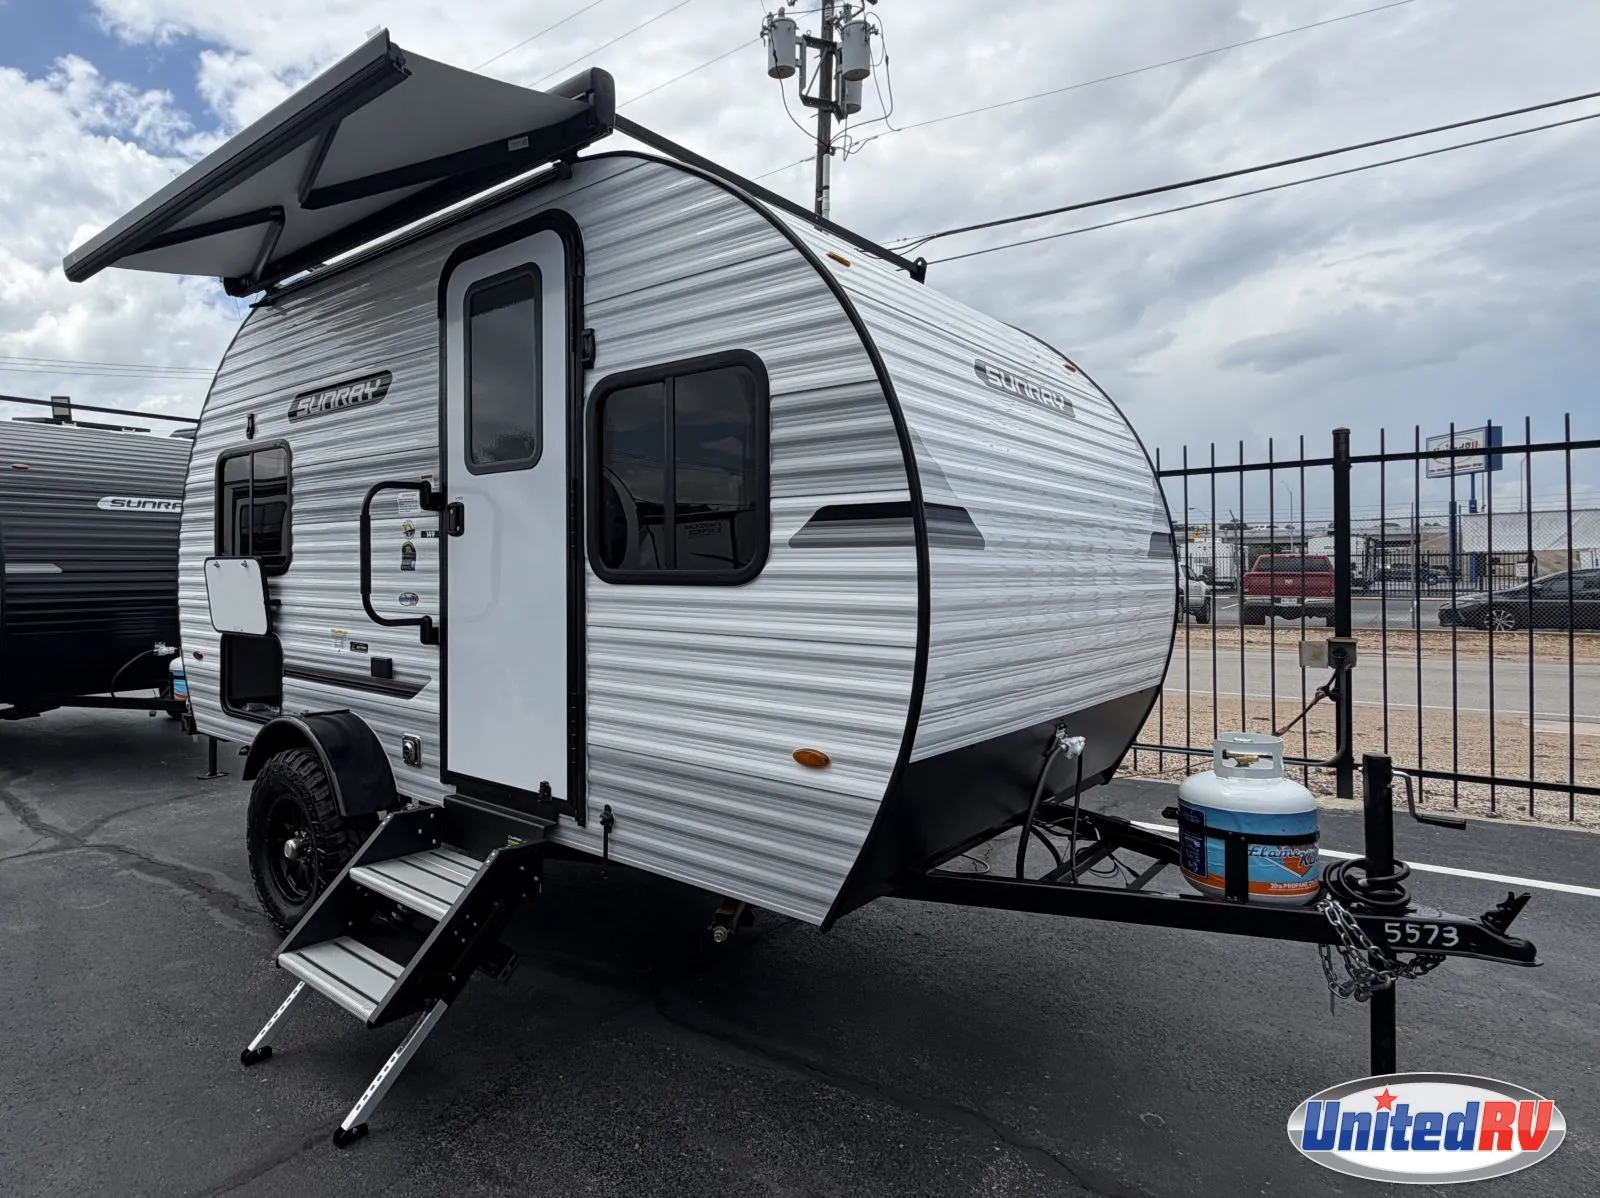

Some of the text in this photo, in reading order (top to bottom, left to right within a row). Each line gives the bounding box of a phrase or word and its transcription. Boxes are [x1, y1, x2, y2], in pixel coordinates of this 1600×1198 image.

[296, 379, 382, 417] SUNRAY
[985, 365, 1065, 411] SUNRAY
[109, 499, 183, 511] SUNRA
[1247, 845, 1302, 865] Flame
[1384, 922, 1460, 947] 5573
